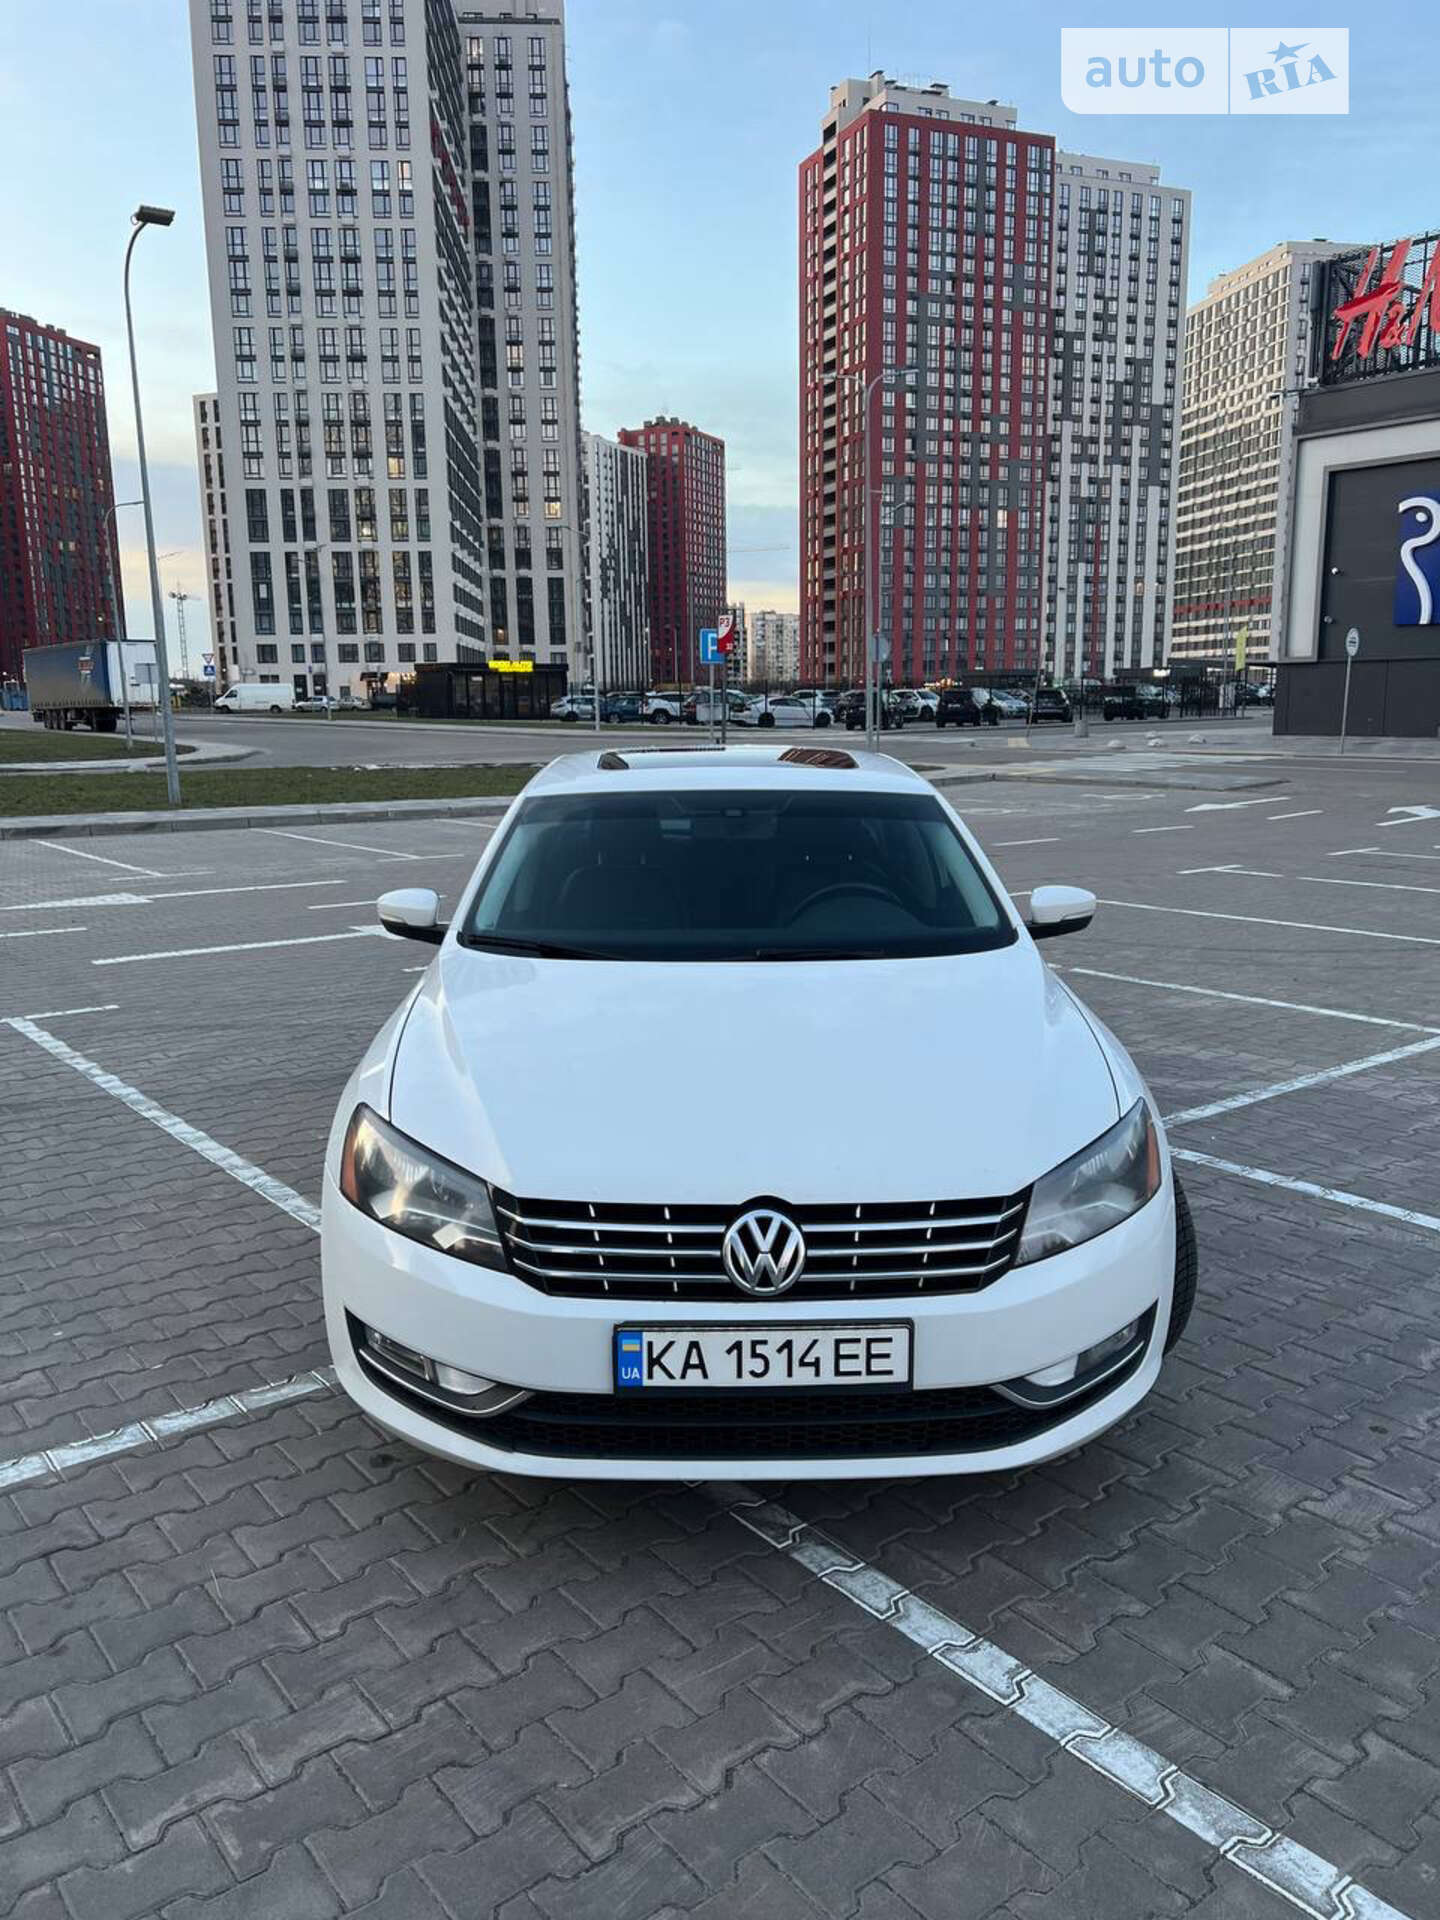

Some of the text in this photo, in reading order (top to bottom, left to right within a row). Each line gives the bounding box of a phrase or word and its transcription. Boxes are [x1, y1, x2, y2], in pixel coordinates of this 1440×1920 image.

[647, 1337, 894, 1380] KA 1514 EE
[622, 1367, 640, 1379] UA
